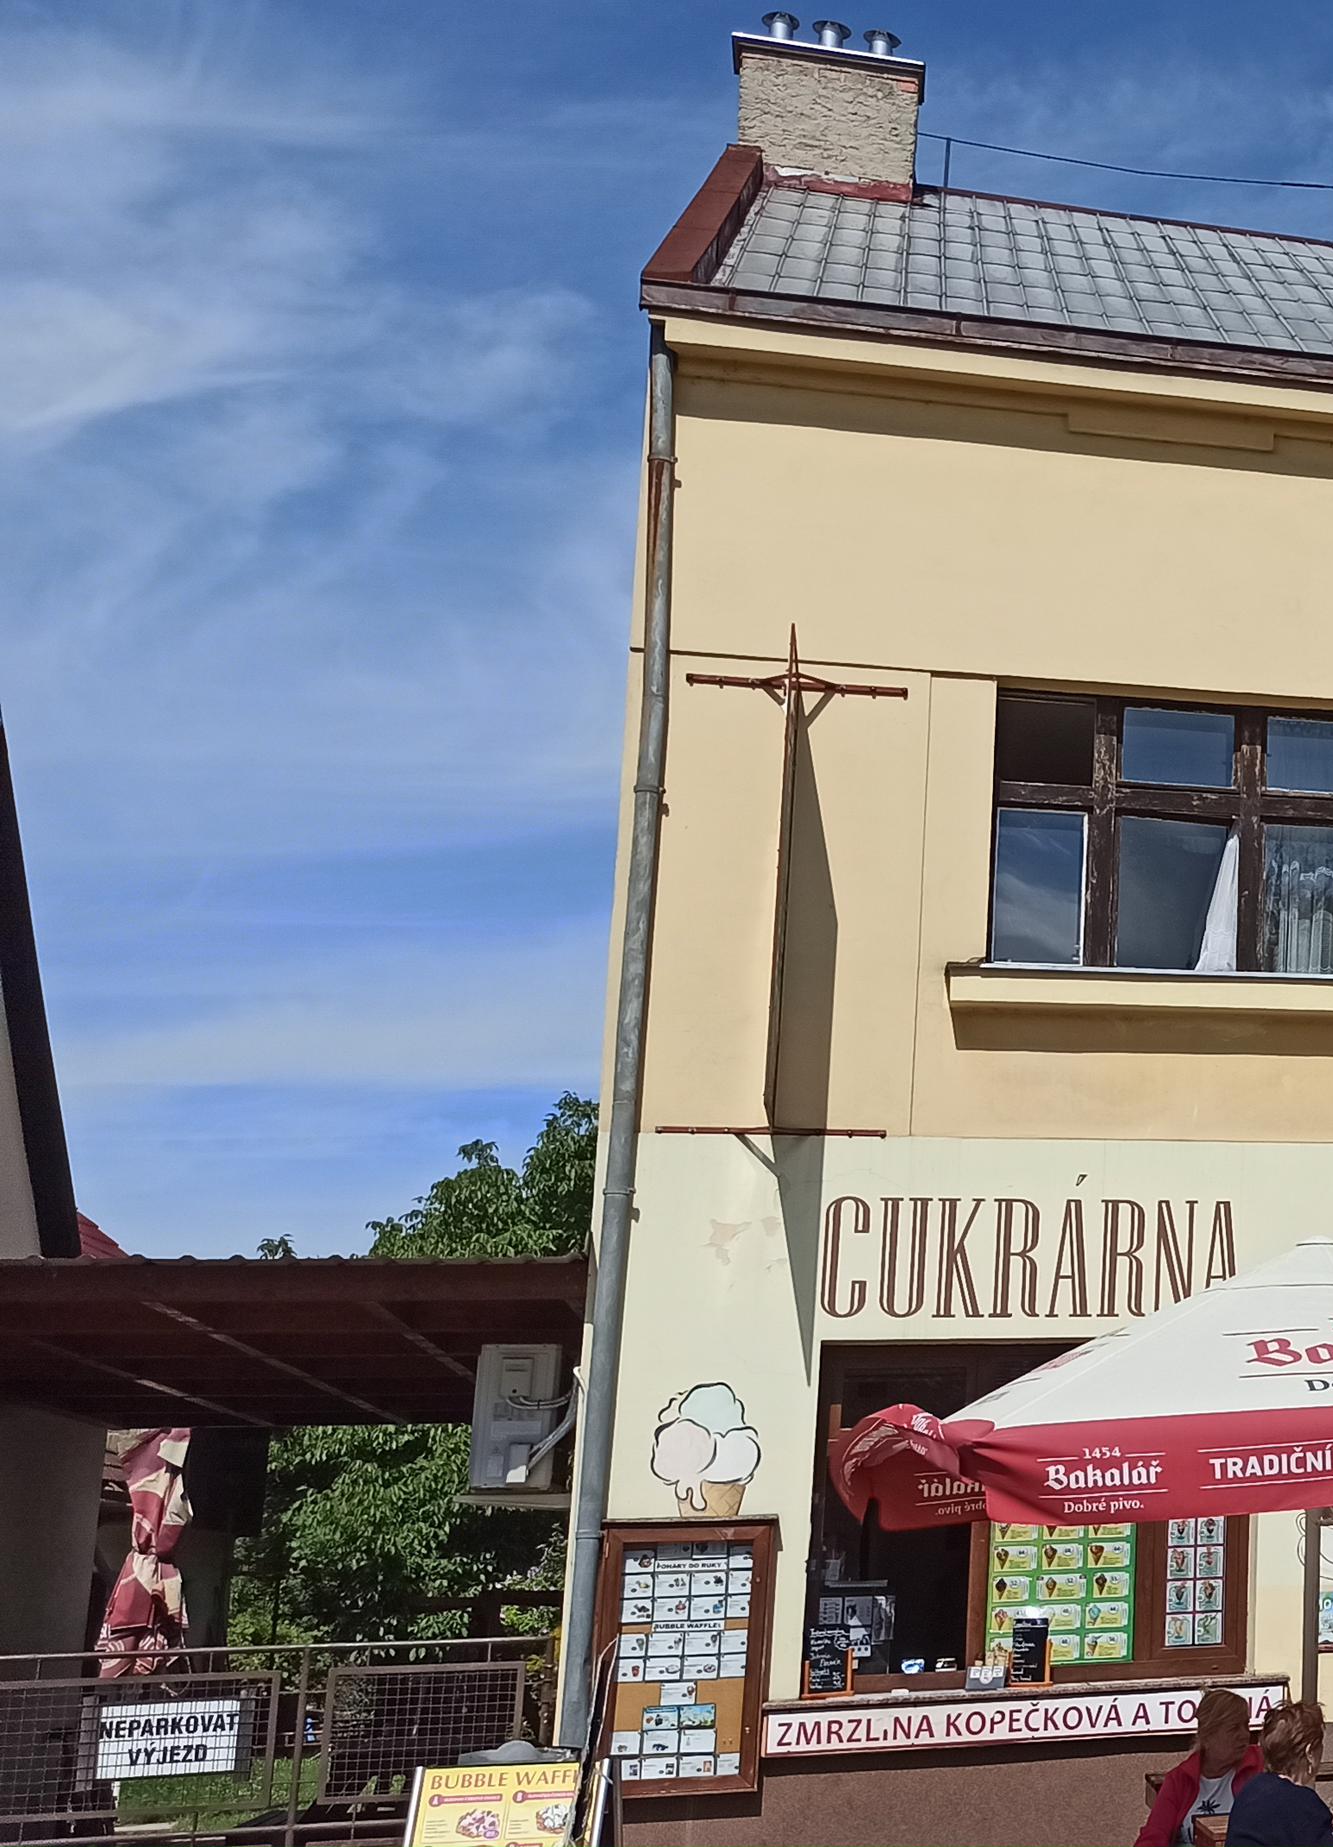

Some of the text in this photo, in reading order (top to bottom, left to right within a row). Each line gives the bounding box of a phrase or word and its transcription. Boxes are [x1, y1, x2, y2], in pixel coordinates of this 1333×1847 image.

[820, 1174, 1238, 1318] CUKRÁRNA
[1082, 1446, 1122, 1459] 1454
[1209, 1443, 1333, 1481] TRADIČNÍ
[1044, 1460, 1163, 1490] Bakalář
[1063, 1497, 1145, 1514] Dobré pivo.
[101, 1713, 239, 1739] NEPARKOVAT
[945, 1697, 1121, 1738] KOPEČKOVÁ
[1131, 1702, 1152, 1727] A
[1160, 1689, 1273, 1727] TOÁ
[128, 1741, 208, 1766] VÝJEZD
[430, 1771, 509, 1790] BUBBLE
